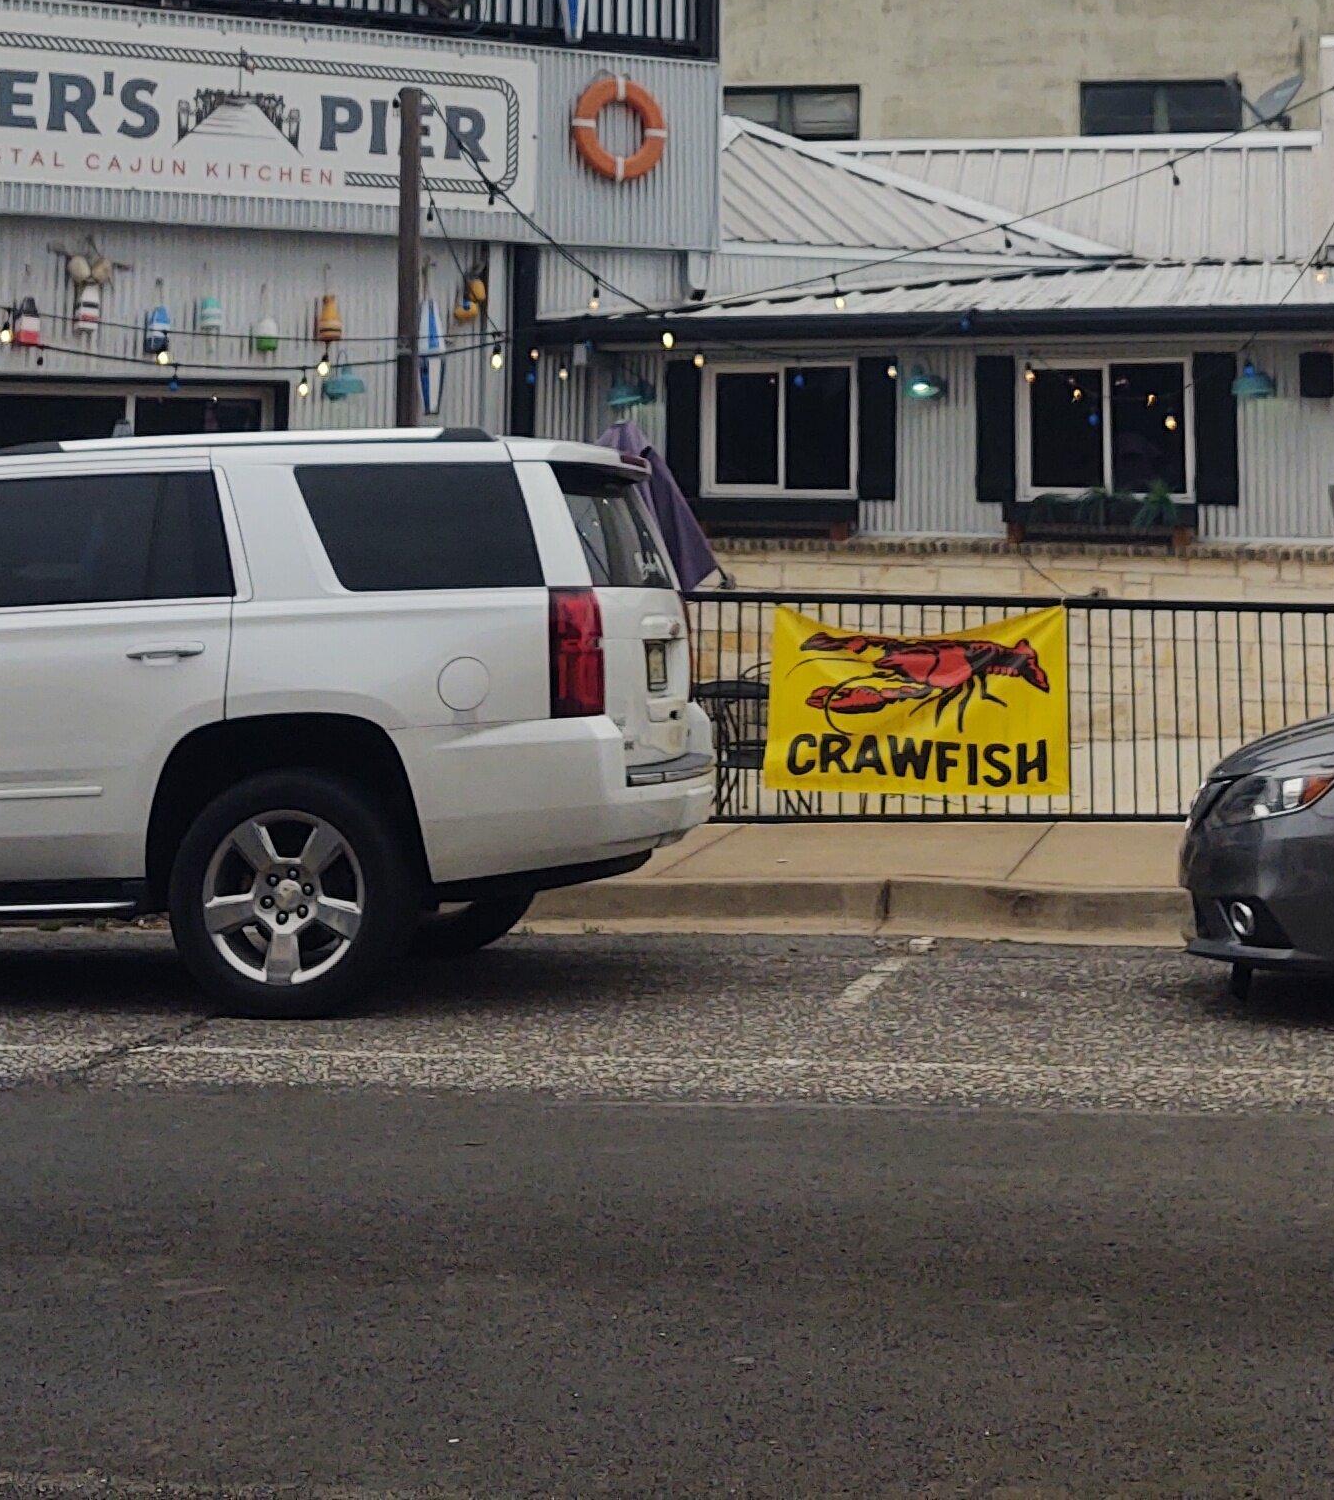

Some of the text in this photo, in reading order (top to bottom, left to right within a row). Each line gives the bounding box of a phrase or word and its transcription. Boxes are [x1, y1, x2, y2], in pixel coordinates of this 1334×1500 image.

[84, 153, 187, 177] CAJUN
[205, 161, 335, 186] KITCHEN
[786, 732, 1049, 788] CRAWFISH
